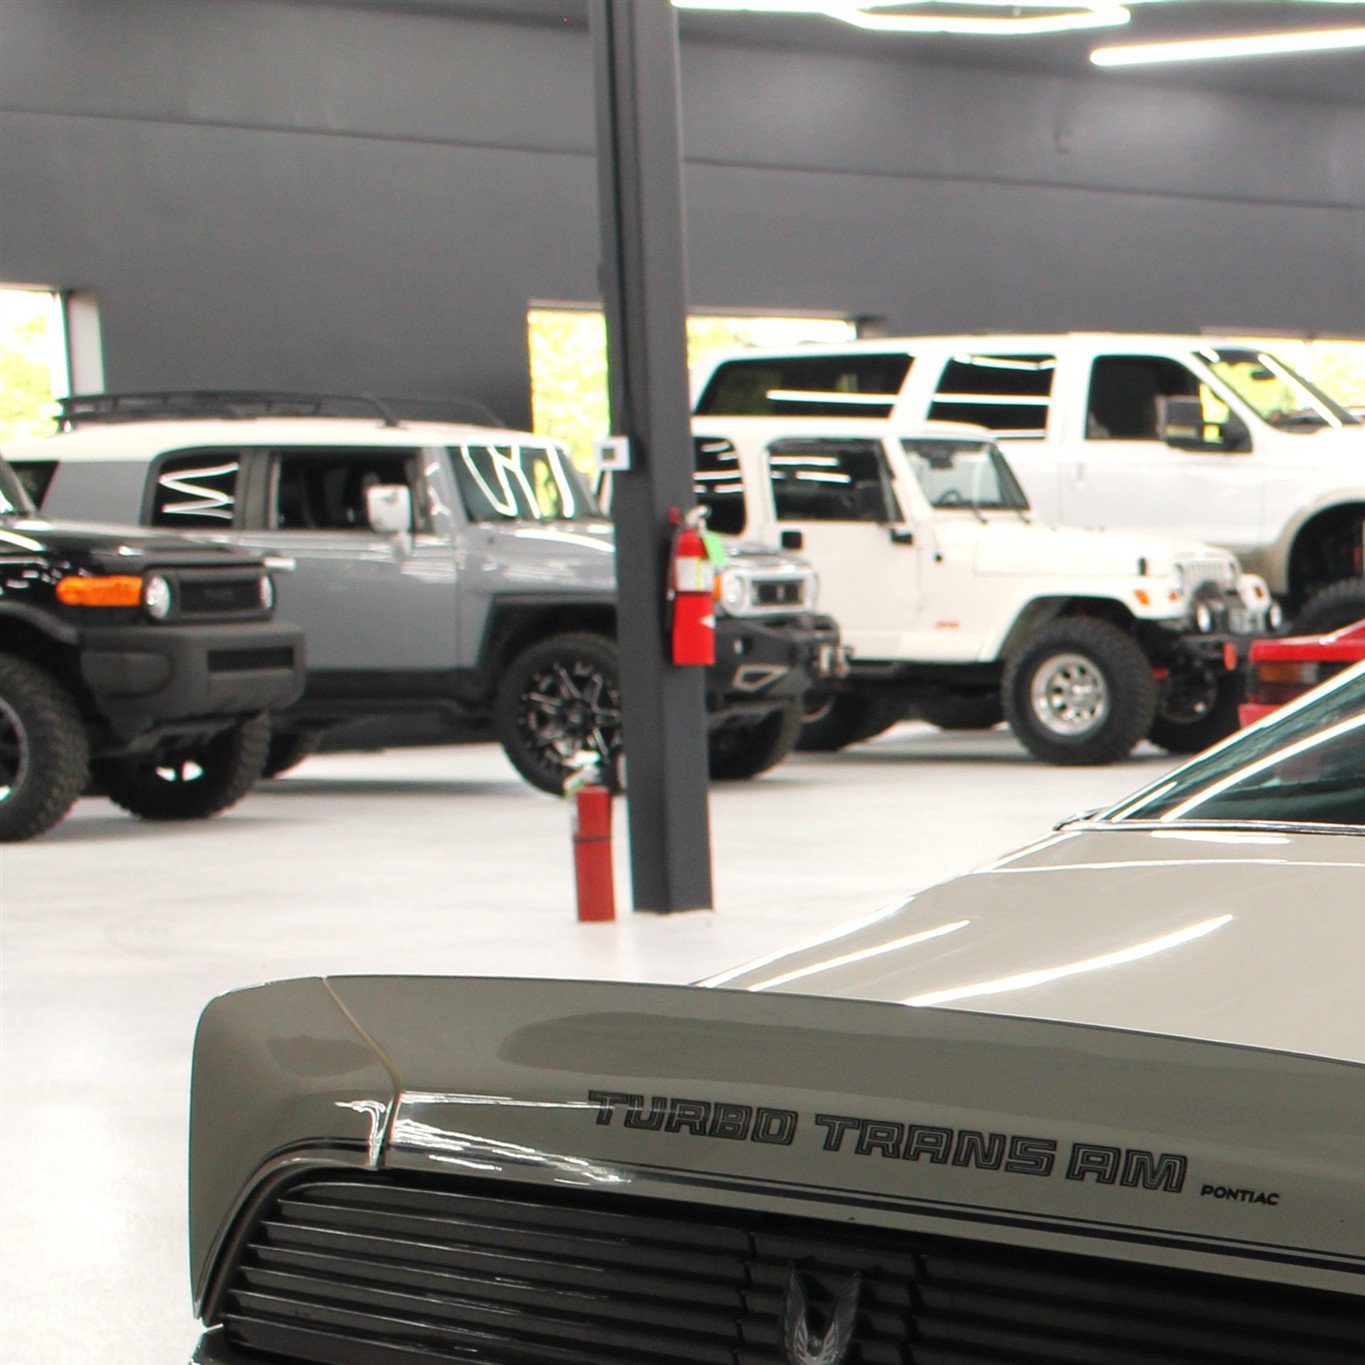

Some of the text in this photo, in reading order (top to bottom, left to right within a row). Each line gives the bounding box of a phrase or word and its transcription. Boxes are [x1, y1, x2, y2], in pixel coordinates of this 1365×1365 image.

[588, 1089, 1189, 1193] TURBO TRANS AM
[1200, 1183, 1281, 1207] PONTIAC
